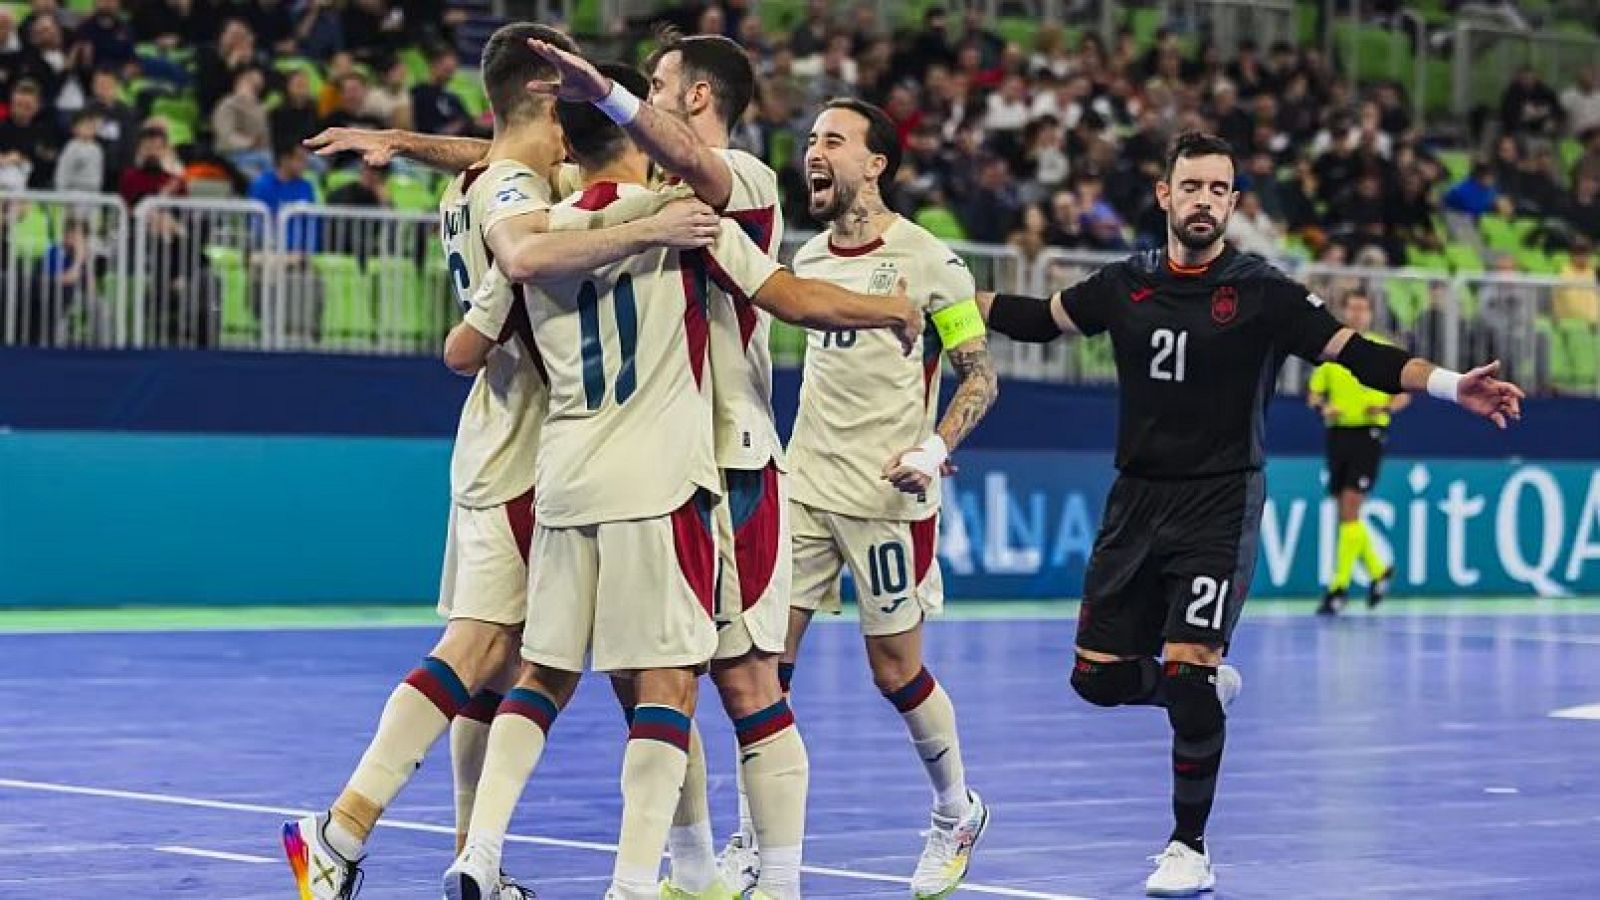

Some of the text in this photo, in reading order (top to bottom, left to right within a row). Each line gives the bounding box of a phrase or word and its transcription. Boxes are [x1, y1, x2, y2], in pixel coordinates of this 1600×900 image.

[577, 273, 638, 411] 11
[1150, 328, 1188, 382] 21
[868, 541, 908, 596] 10
[1185, 576, 1229, 630] 21
